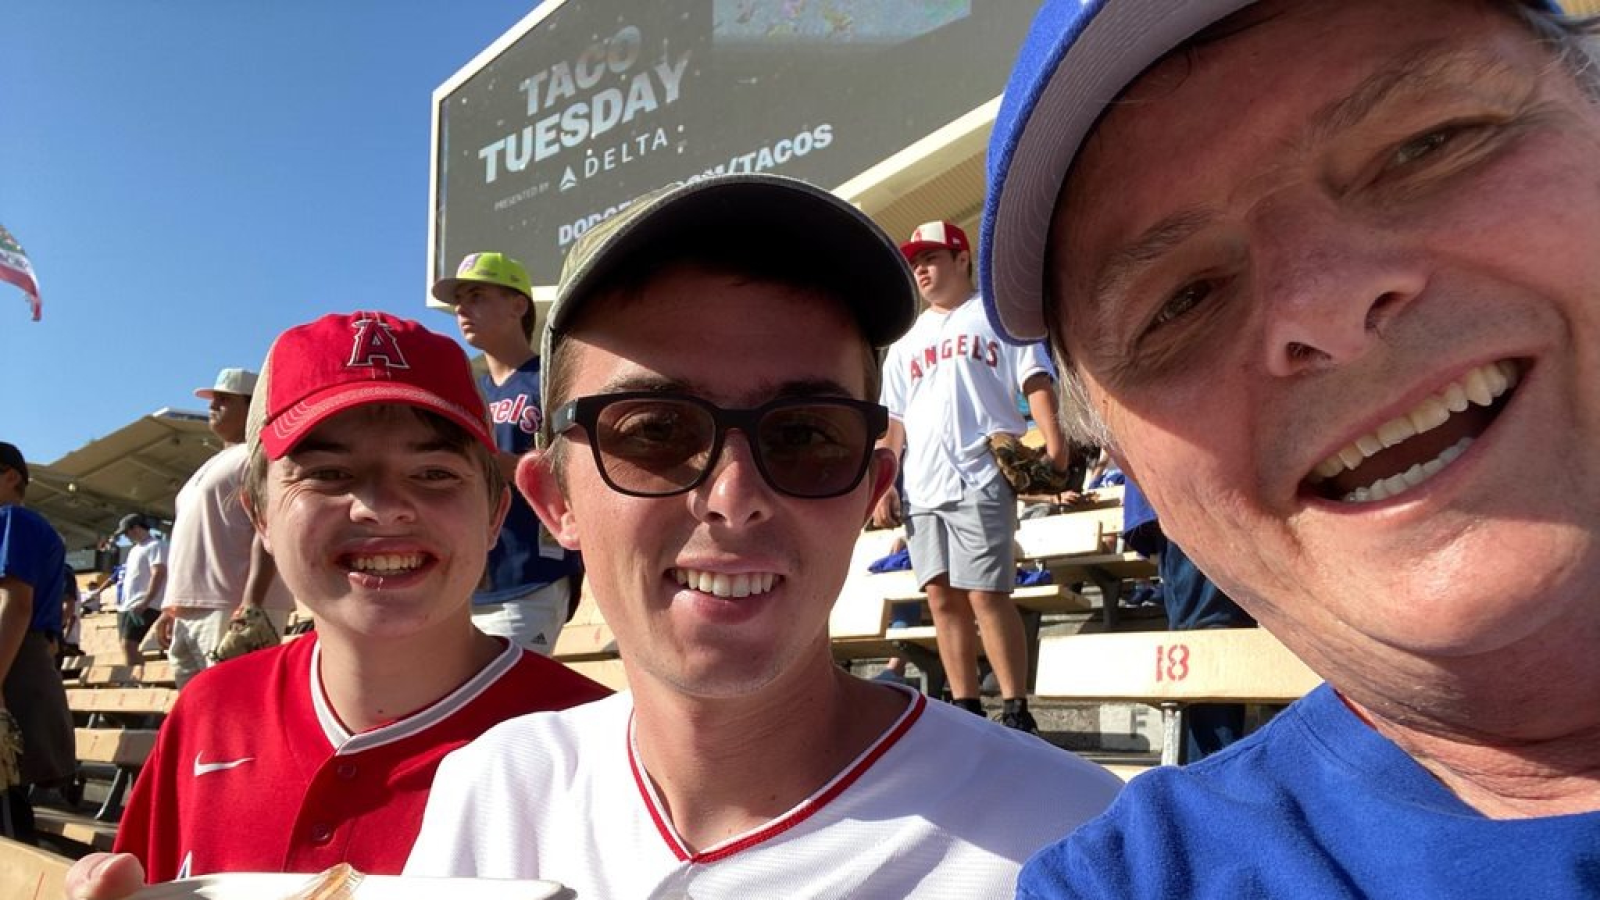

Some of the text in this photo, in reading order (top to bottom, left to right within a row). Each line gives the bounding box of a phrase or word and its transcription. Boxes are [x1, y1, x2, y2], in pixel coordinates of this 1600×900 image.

[519, 25, 642, 116] TACO
[478, 49, 692, 184] TUESDAY
[585, 127, 668, 178] DELTA
[346, 311, 411, 369] A
[910, 333, 998, 381] ANGELS
[1156, 644, 1190, 682] 18
